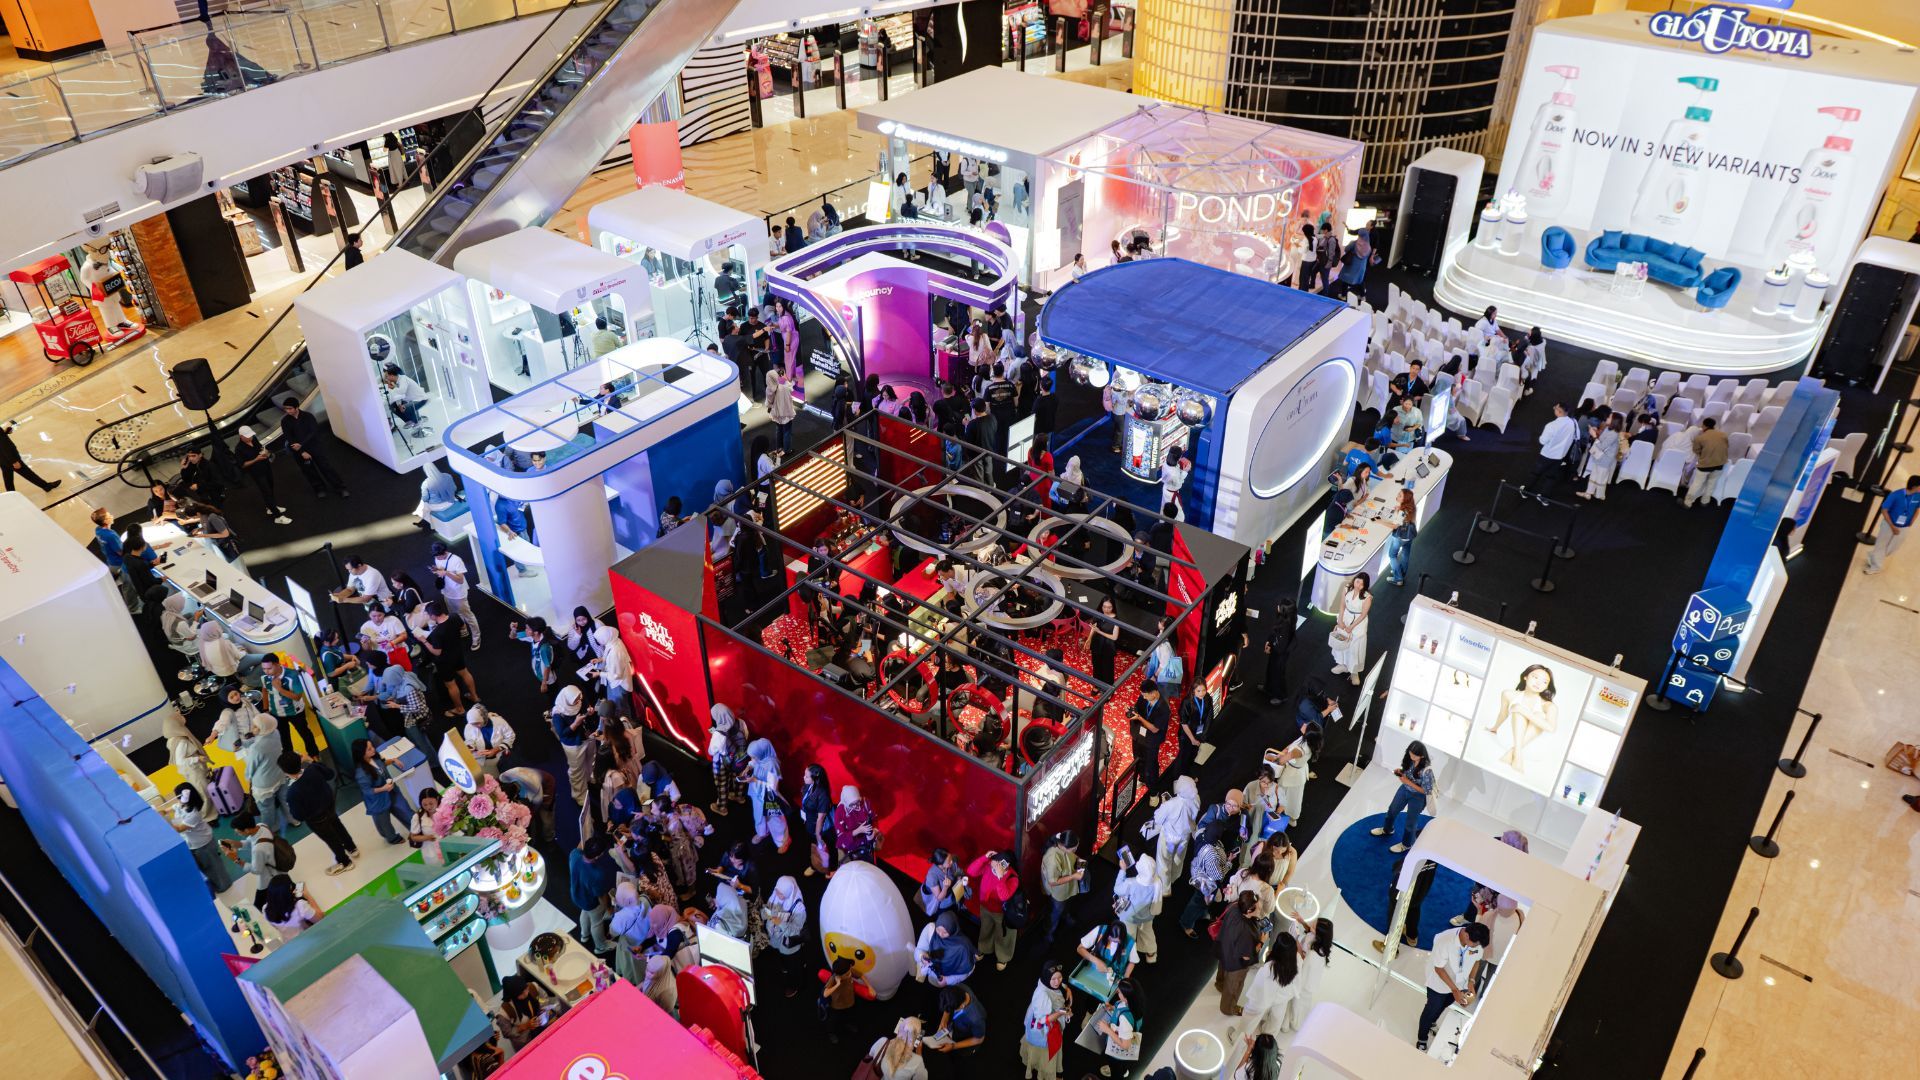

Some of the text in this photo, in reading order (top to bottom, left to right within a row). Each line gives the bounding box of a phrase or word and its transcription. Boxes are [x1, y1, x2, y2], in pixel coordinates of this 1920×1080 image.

[1572, 128, 1802, 184] NOW IN 3 NEW VARIANTS
[1810, 167, 1838, 180] Dove
[1178, 188, 1294, 223] POND'S
[68, 321, 97, 339] Kiehl's
[1032, 750, 1092, 821] HAIR CAFE
